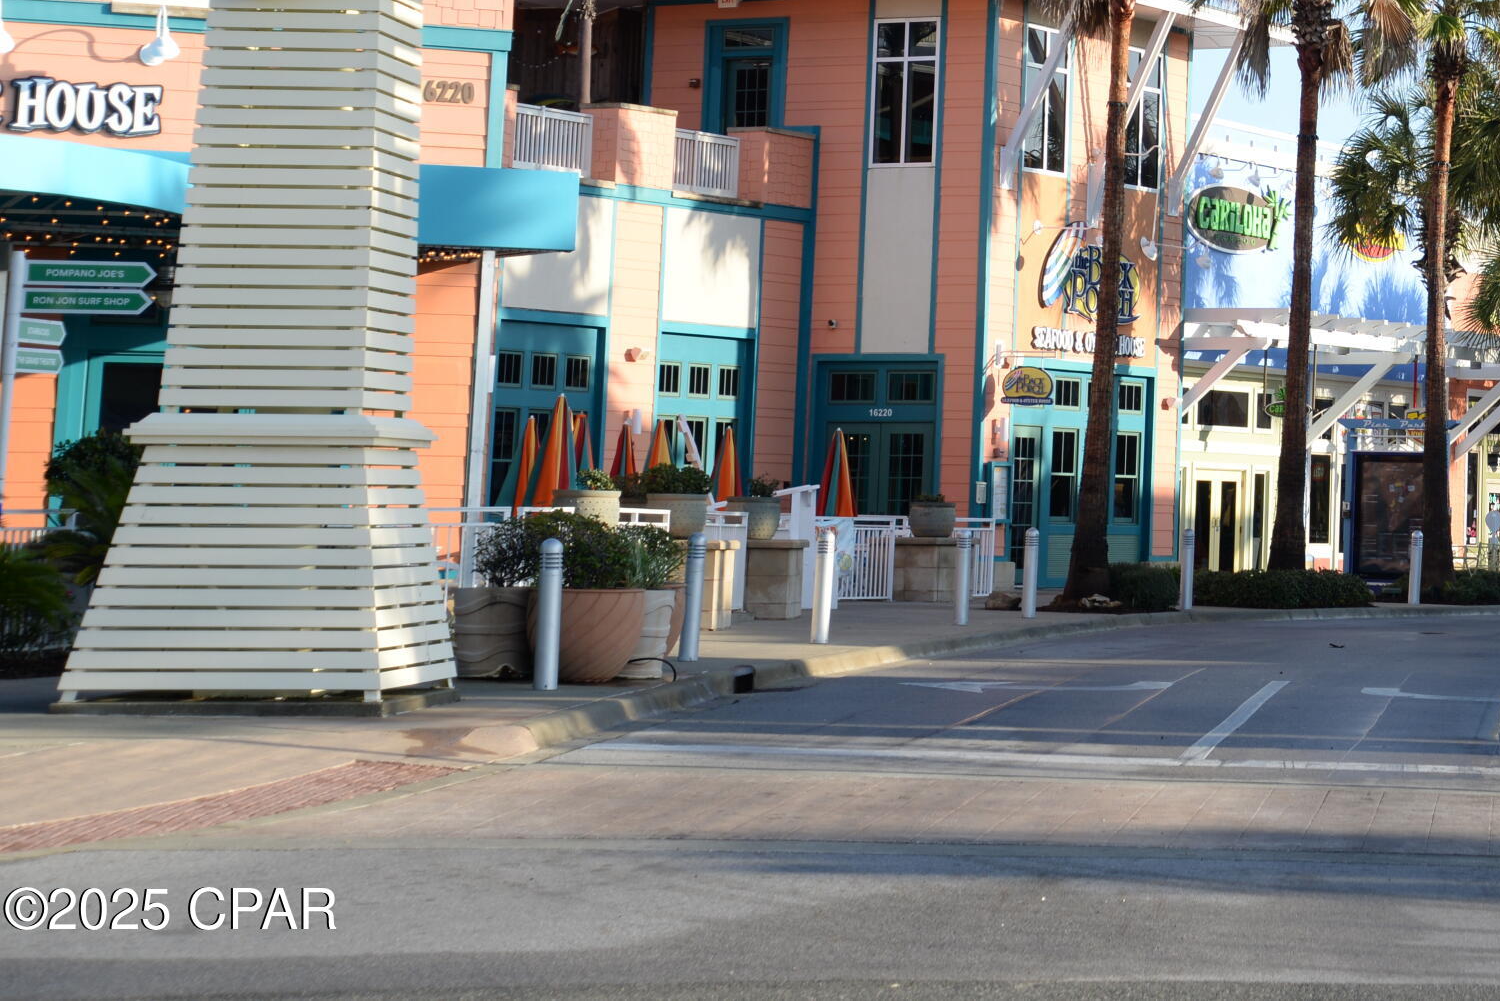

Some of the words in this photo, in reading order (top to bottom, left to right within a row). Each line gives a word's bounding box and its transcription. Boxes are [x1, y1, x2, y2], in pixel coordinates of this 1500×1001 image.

[8, 77, 163, 137] HOUSE
[45, 268, 96, 278] POMPANO
[97, 270, 125, 278] JOE'S
[32, 296, 55, 305] RON
[55, 297, 77, 305] JON
[78, 297, 102, 306] SURF
[103, 298, 130, 306] SHOP
[1032, 327, 1074, 351] SEAFOOD
[1118, 335, 1145, 357] HOUSE
[868, 408, 893, 417] 16220
[1363, 420, 1391, 428] Pier
